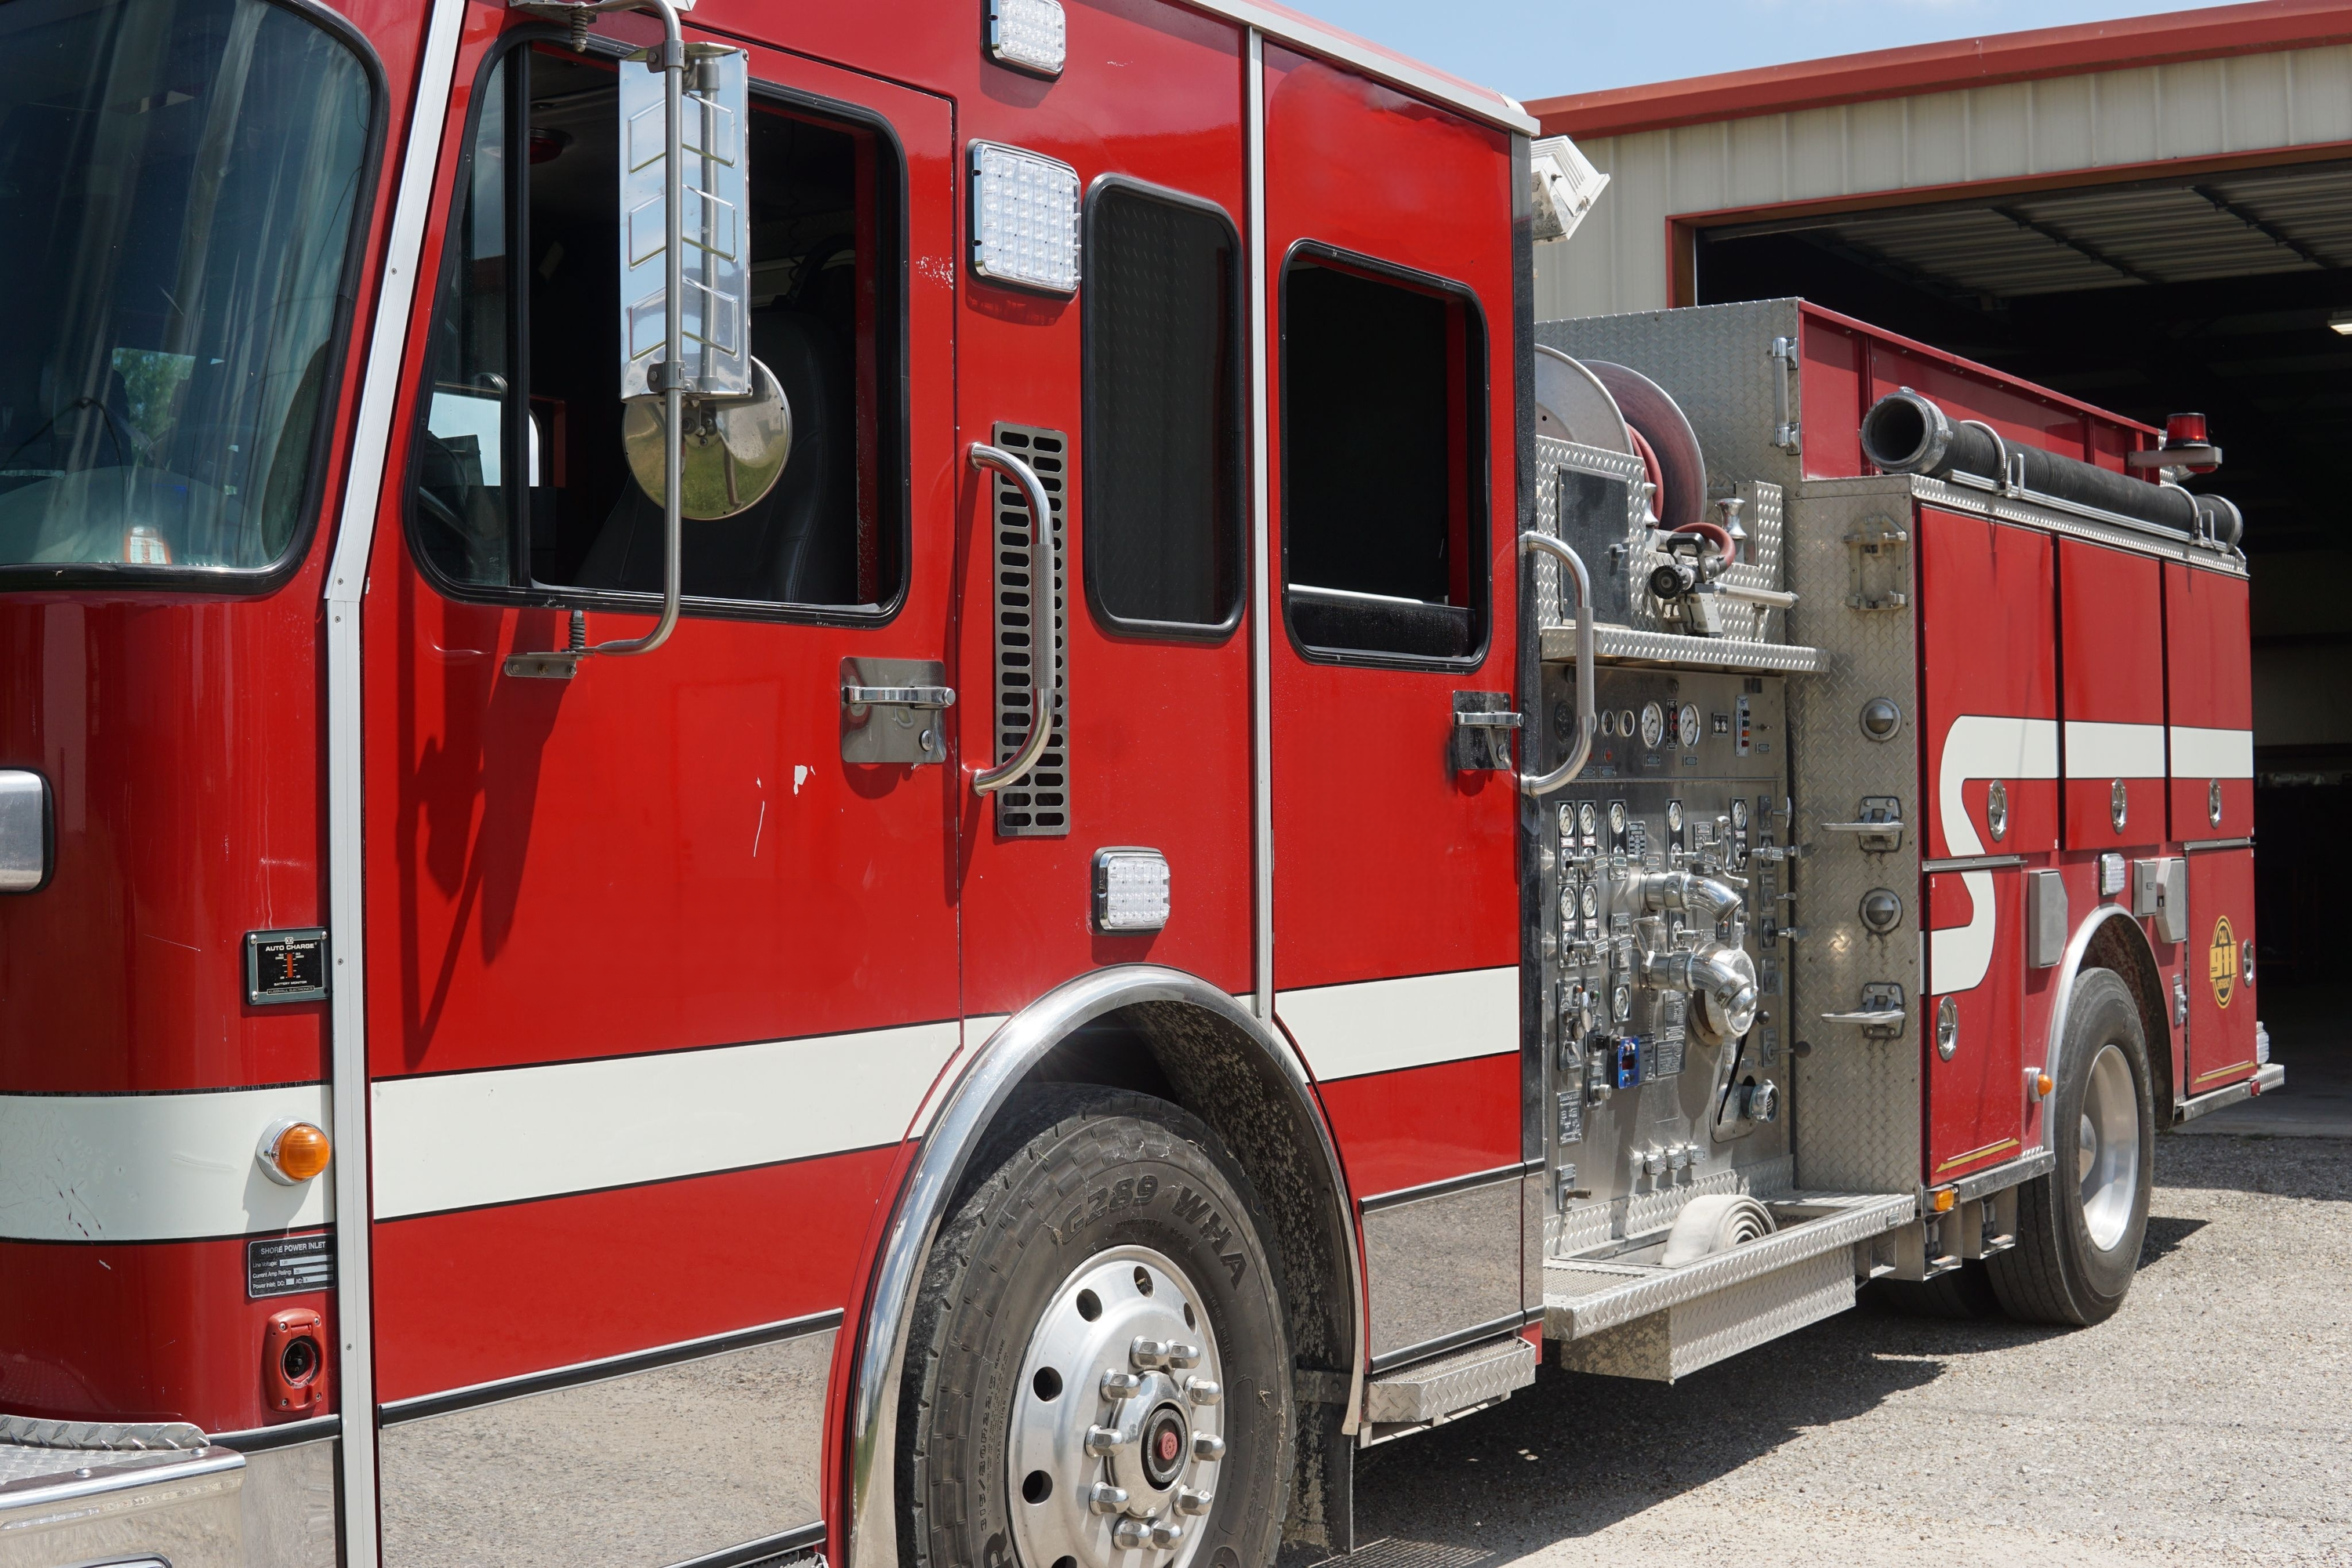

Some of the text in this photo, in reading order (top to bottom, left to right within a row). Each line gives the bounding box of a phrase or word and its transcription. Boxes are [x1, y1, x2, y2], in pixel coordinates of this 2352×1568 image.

[1932, 877, 1936, 888] 1
[2219, 930, 2228, 945] CALL
[2210, 945, 2237, 978] 911
[1061, 1175, 1247, 1291] G289 WHA
[260, 1241, 326, 1254] SHORE POWER INLET
